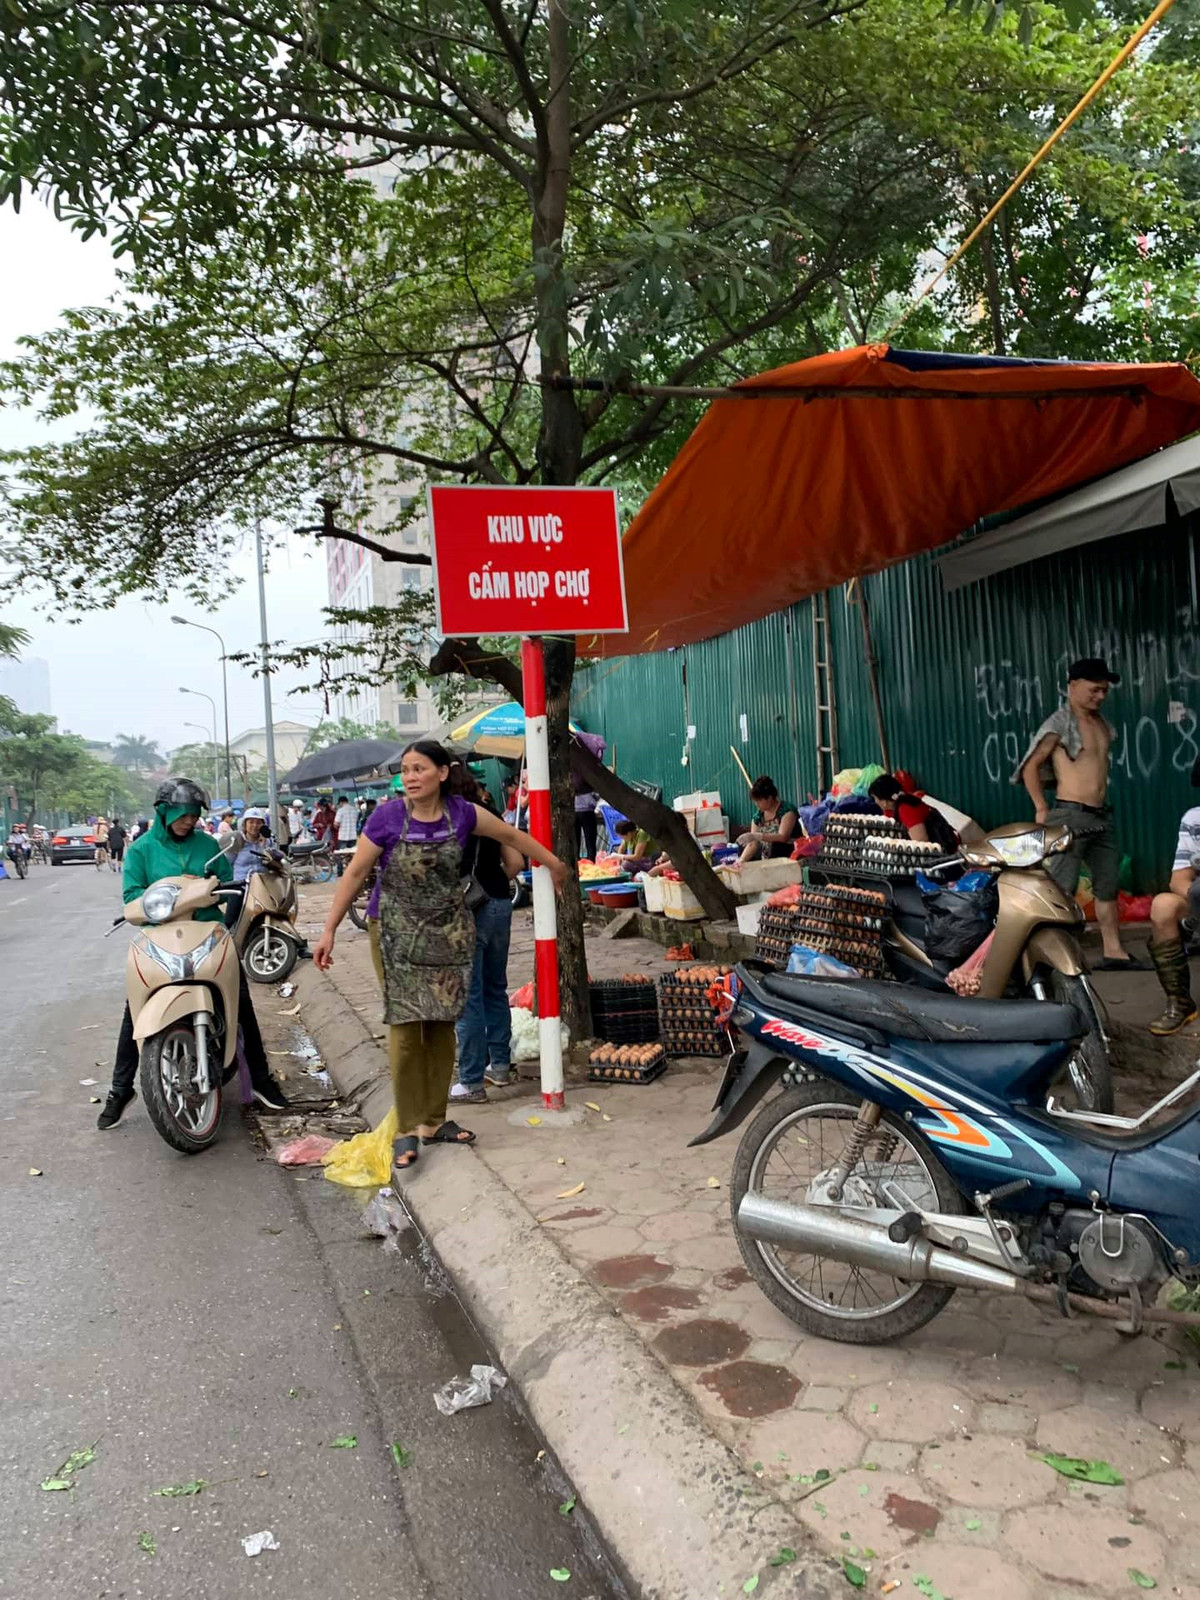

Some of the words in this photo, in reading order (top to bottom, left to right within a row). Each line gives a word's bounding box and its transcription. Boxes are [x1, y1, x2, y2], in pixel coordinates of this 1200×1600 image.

[487, 515, 524, 543] KHU
[528, 513, 563, 552] VỰC
[468, 560, 511, 600] CẤM
[514, 570, 550, 607] HỌP
[554, 568, 590, 606] CHỢ
[761, 1019, 827, 1050] Wave
